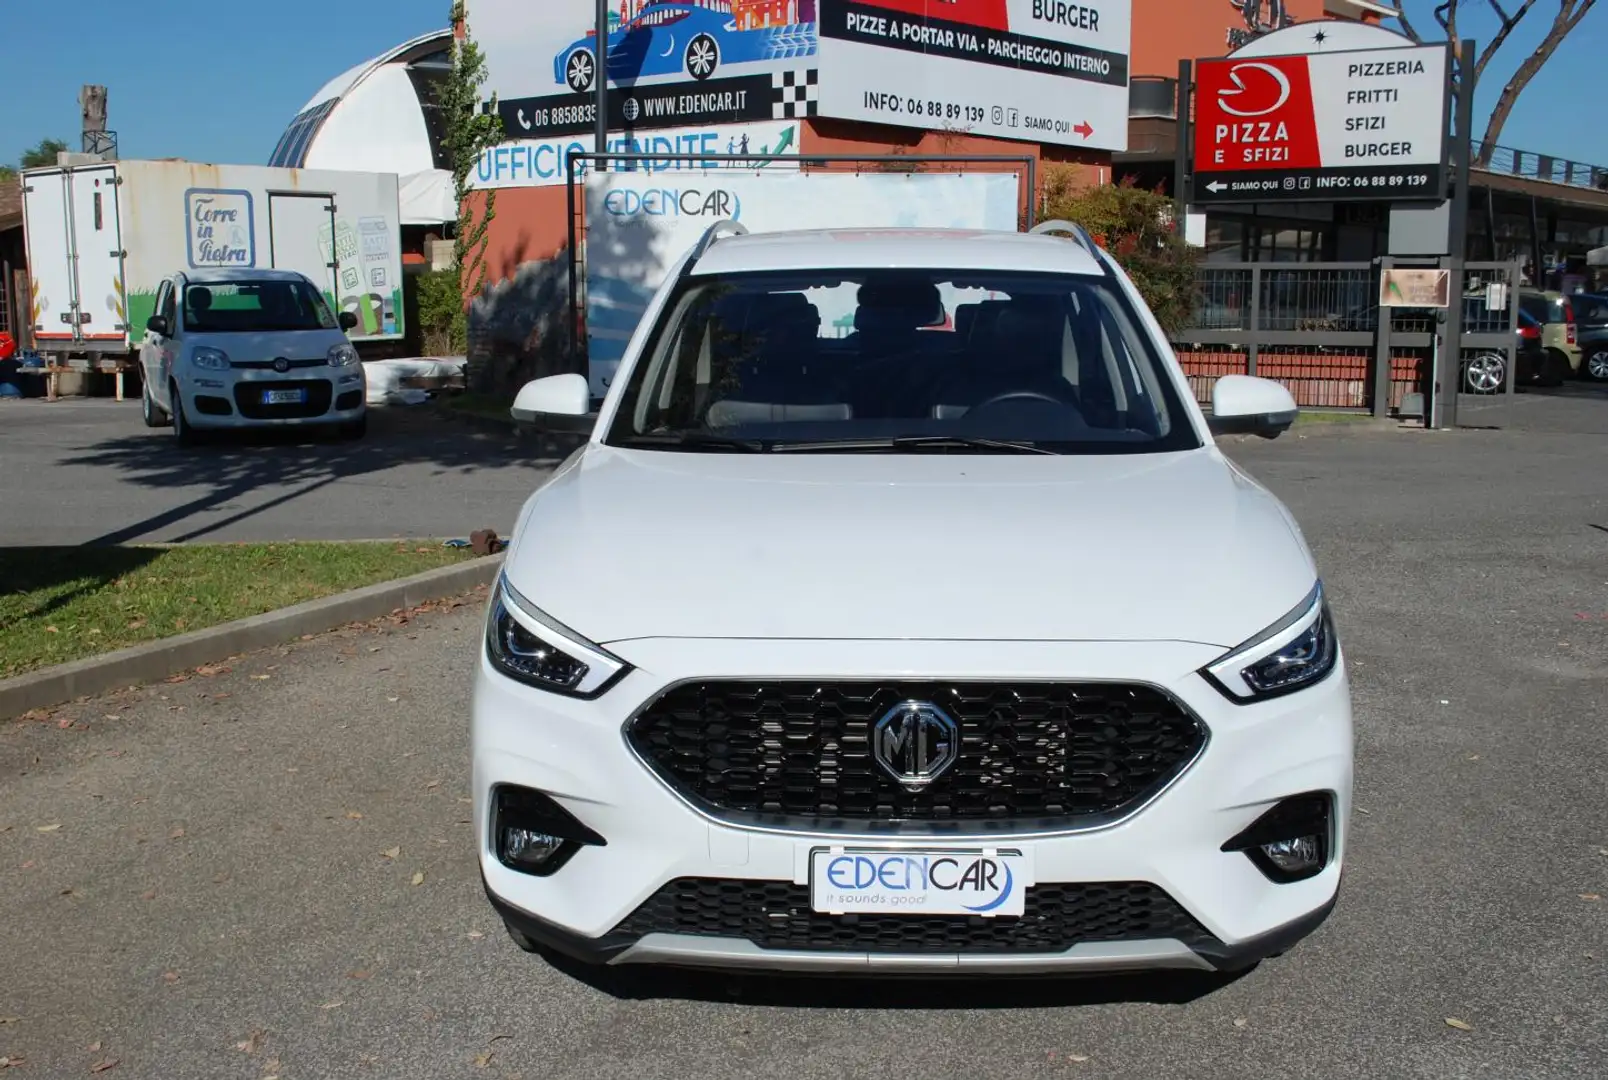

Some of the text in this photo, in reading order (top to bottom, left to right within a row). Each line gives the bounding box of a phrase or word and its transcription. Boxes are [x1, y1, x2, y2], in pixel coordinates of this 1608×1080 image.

[1032, 0, 1099, 32] BURGER
[846, 12, 1110, 75] PIZZE A PORTAR VIA PARCHEGGIO INTERNO
[1348, 60, 1425, 78] PIZZERIA
[643, 91, 746, 117] WWW.EDENCAR.IT
[1347, 88, 1399, 104] FRITTI
[864, 91, 985, 122] INFO: 06 88 89 139
[534, 108, 549, 127] 06
[1024, 116, 1070, 134] SIAMO QUI
[1345, 116, 1386, 131] SFIZI
[1215, 121, 1289, 144] PIZZA
[1214, 146, 1289, 164] E SFIZI
[1345, 141, 1412, 158] BURGER
[1231, 180, 1279, 191] SIAMO QUI
[1316, 174, 1428, 188] INFO: 06 88 89 139
[194, 198, 238, 222] Torre
[604, 188, 731, 216] EDENCAR
[197, 223, 213, 239] in
[199, 238, 247, 262] Pietra
[883, 712, 949, 775] MG
[827, 856, 999, 892] EDENCAR
[838, 893, 886, 904] sounds
